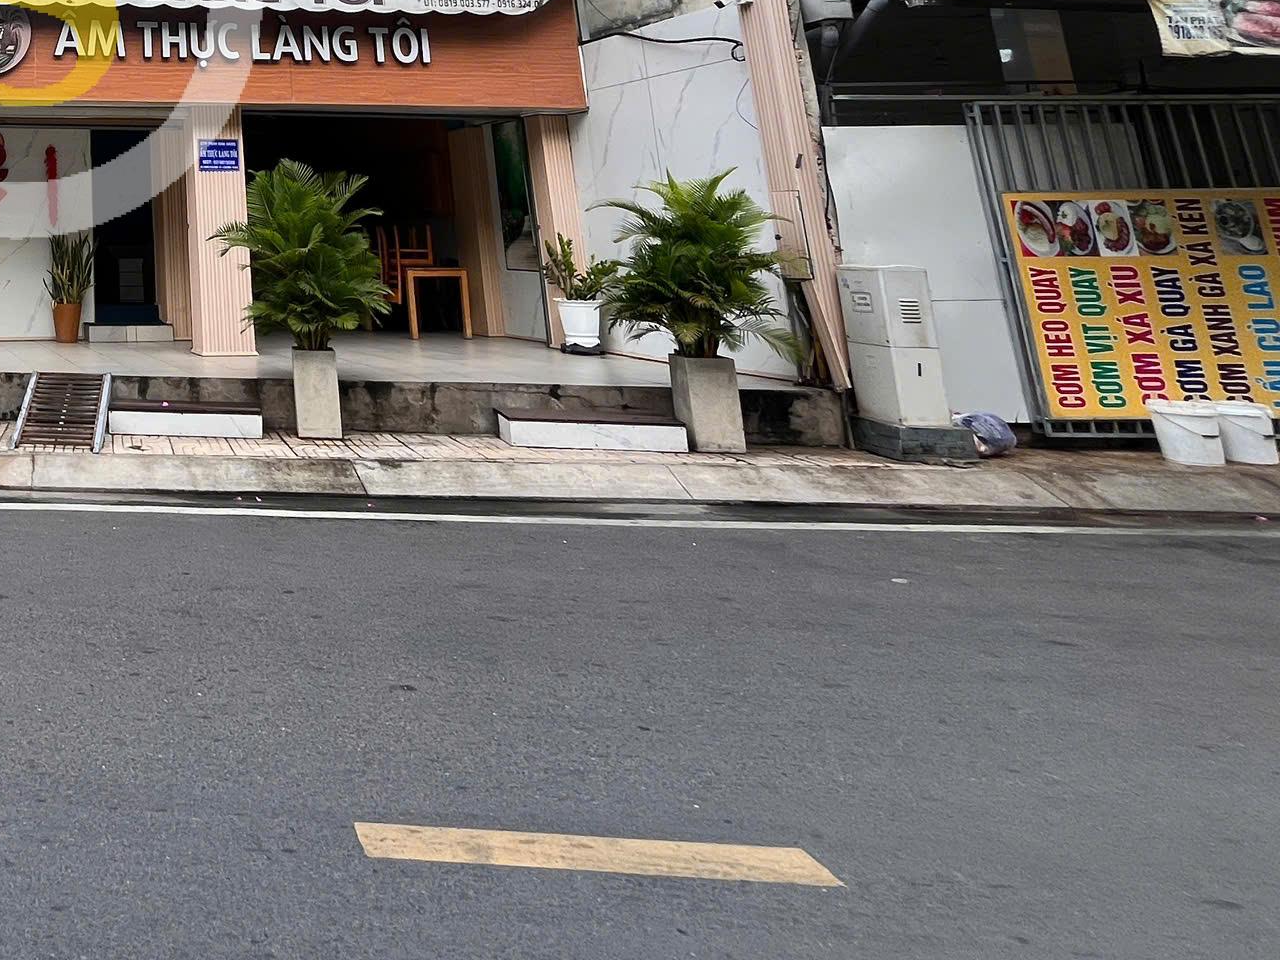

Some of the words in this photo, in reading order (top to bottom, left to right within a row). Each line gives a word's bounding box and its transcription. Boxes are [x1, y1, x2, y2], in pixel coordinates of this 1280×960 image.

[497, 0, 543, 9] 0916.324.0
[136, 19, 241, 68] THỰC
[253, 14, 359, 63] LÀNG
[368, 17, 432, 64] TÔI
[1172, 198, 1209, 236] KÉN
[1180, 241, 1218, 267] XÁ
[1029, 267, 1067, 314] QUAY
[1068, 267, 1107, 317] QUAY
[1107, 266, 1146, 305] XÍU
[1151, 266, 1191, 317] QUAY
[1188, 272, 1226, 298] GÀ
[1238, 266, 1275, 310] LAO
[1041, 320, 1076, 357] HEO
[1081, 323, 1119, 354] VỊT
[1116, 313, 1156, 345] XÁ
[1160, 324, 1198, 353] GÀ
[1202, 304, 1242, 357] XANH
[1052, 364, 1086, 409] CƠM
[1090, 361, 1127, 409] CƠM
[1255, 360, 1280, 408] ẨU
